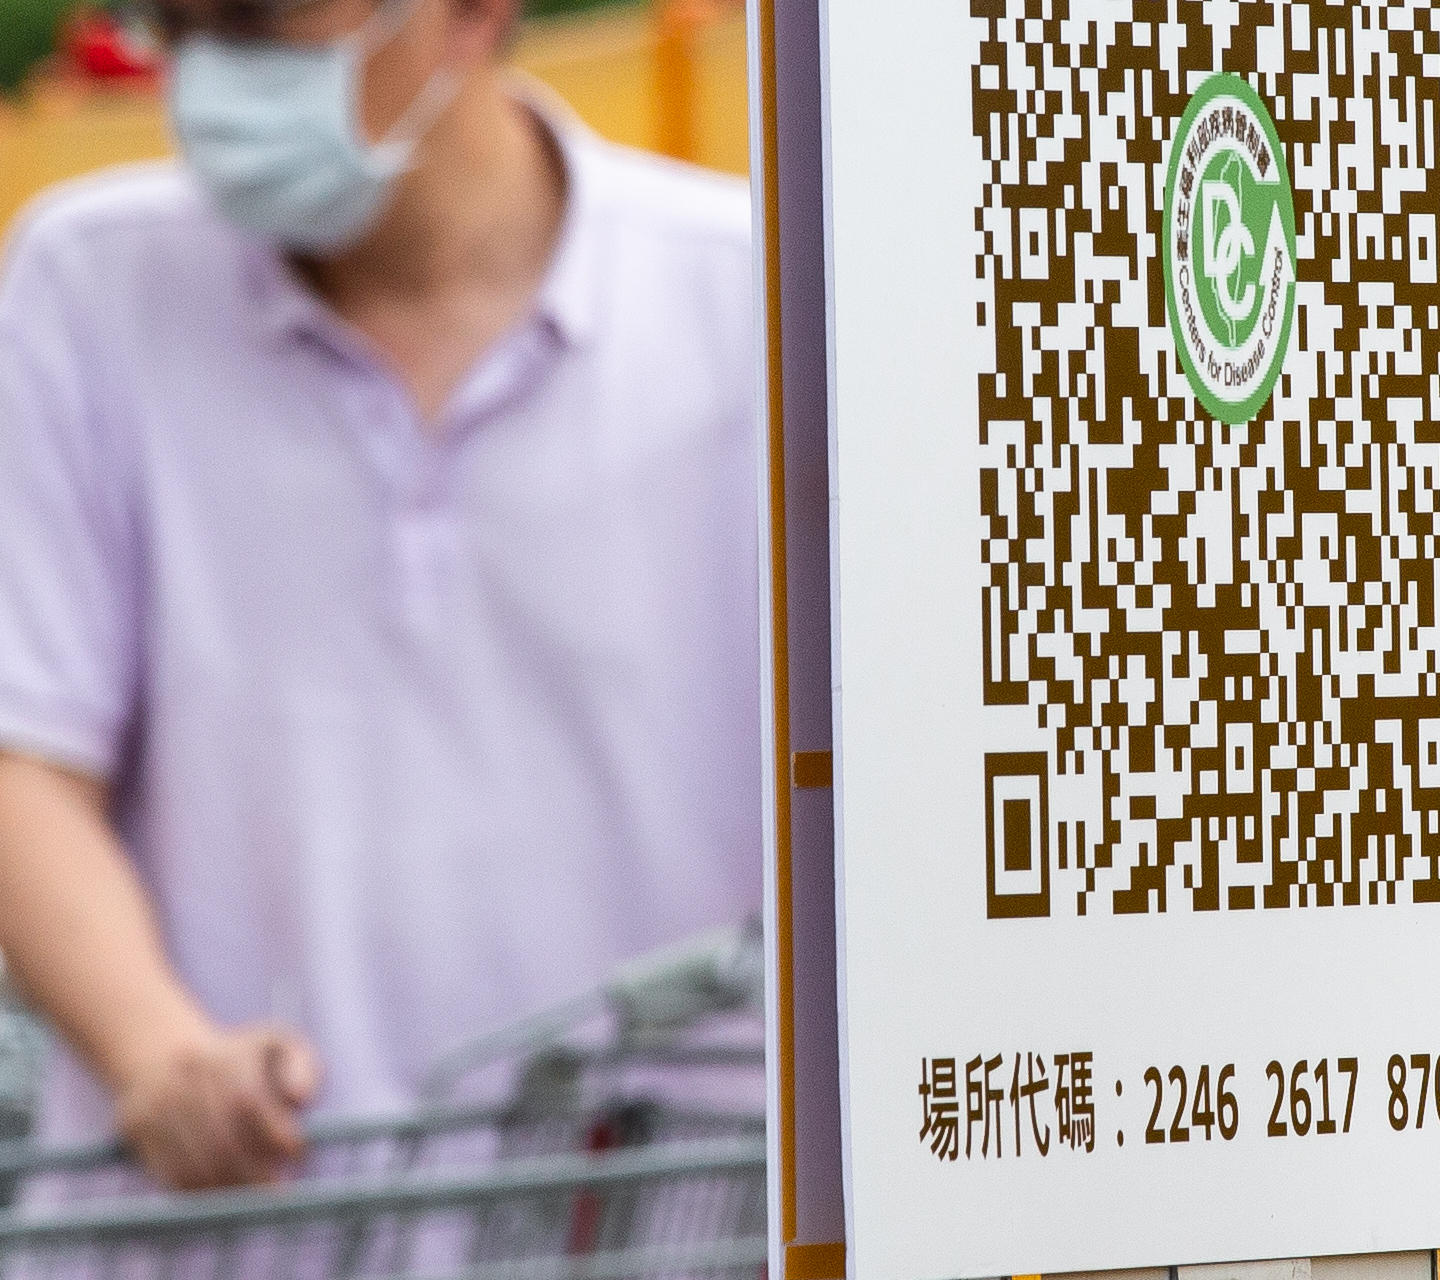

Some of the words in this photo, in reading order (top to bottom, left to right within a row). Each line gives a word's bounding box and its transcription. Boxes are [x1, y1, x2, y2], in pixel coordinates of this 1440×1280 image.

[1207, 350, 1222, 383] for
[1224, 338, 1266, 387] Disease
[1265, 1056, 1360, 1139] 2617
